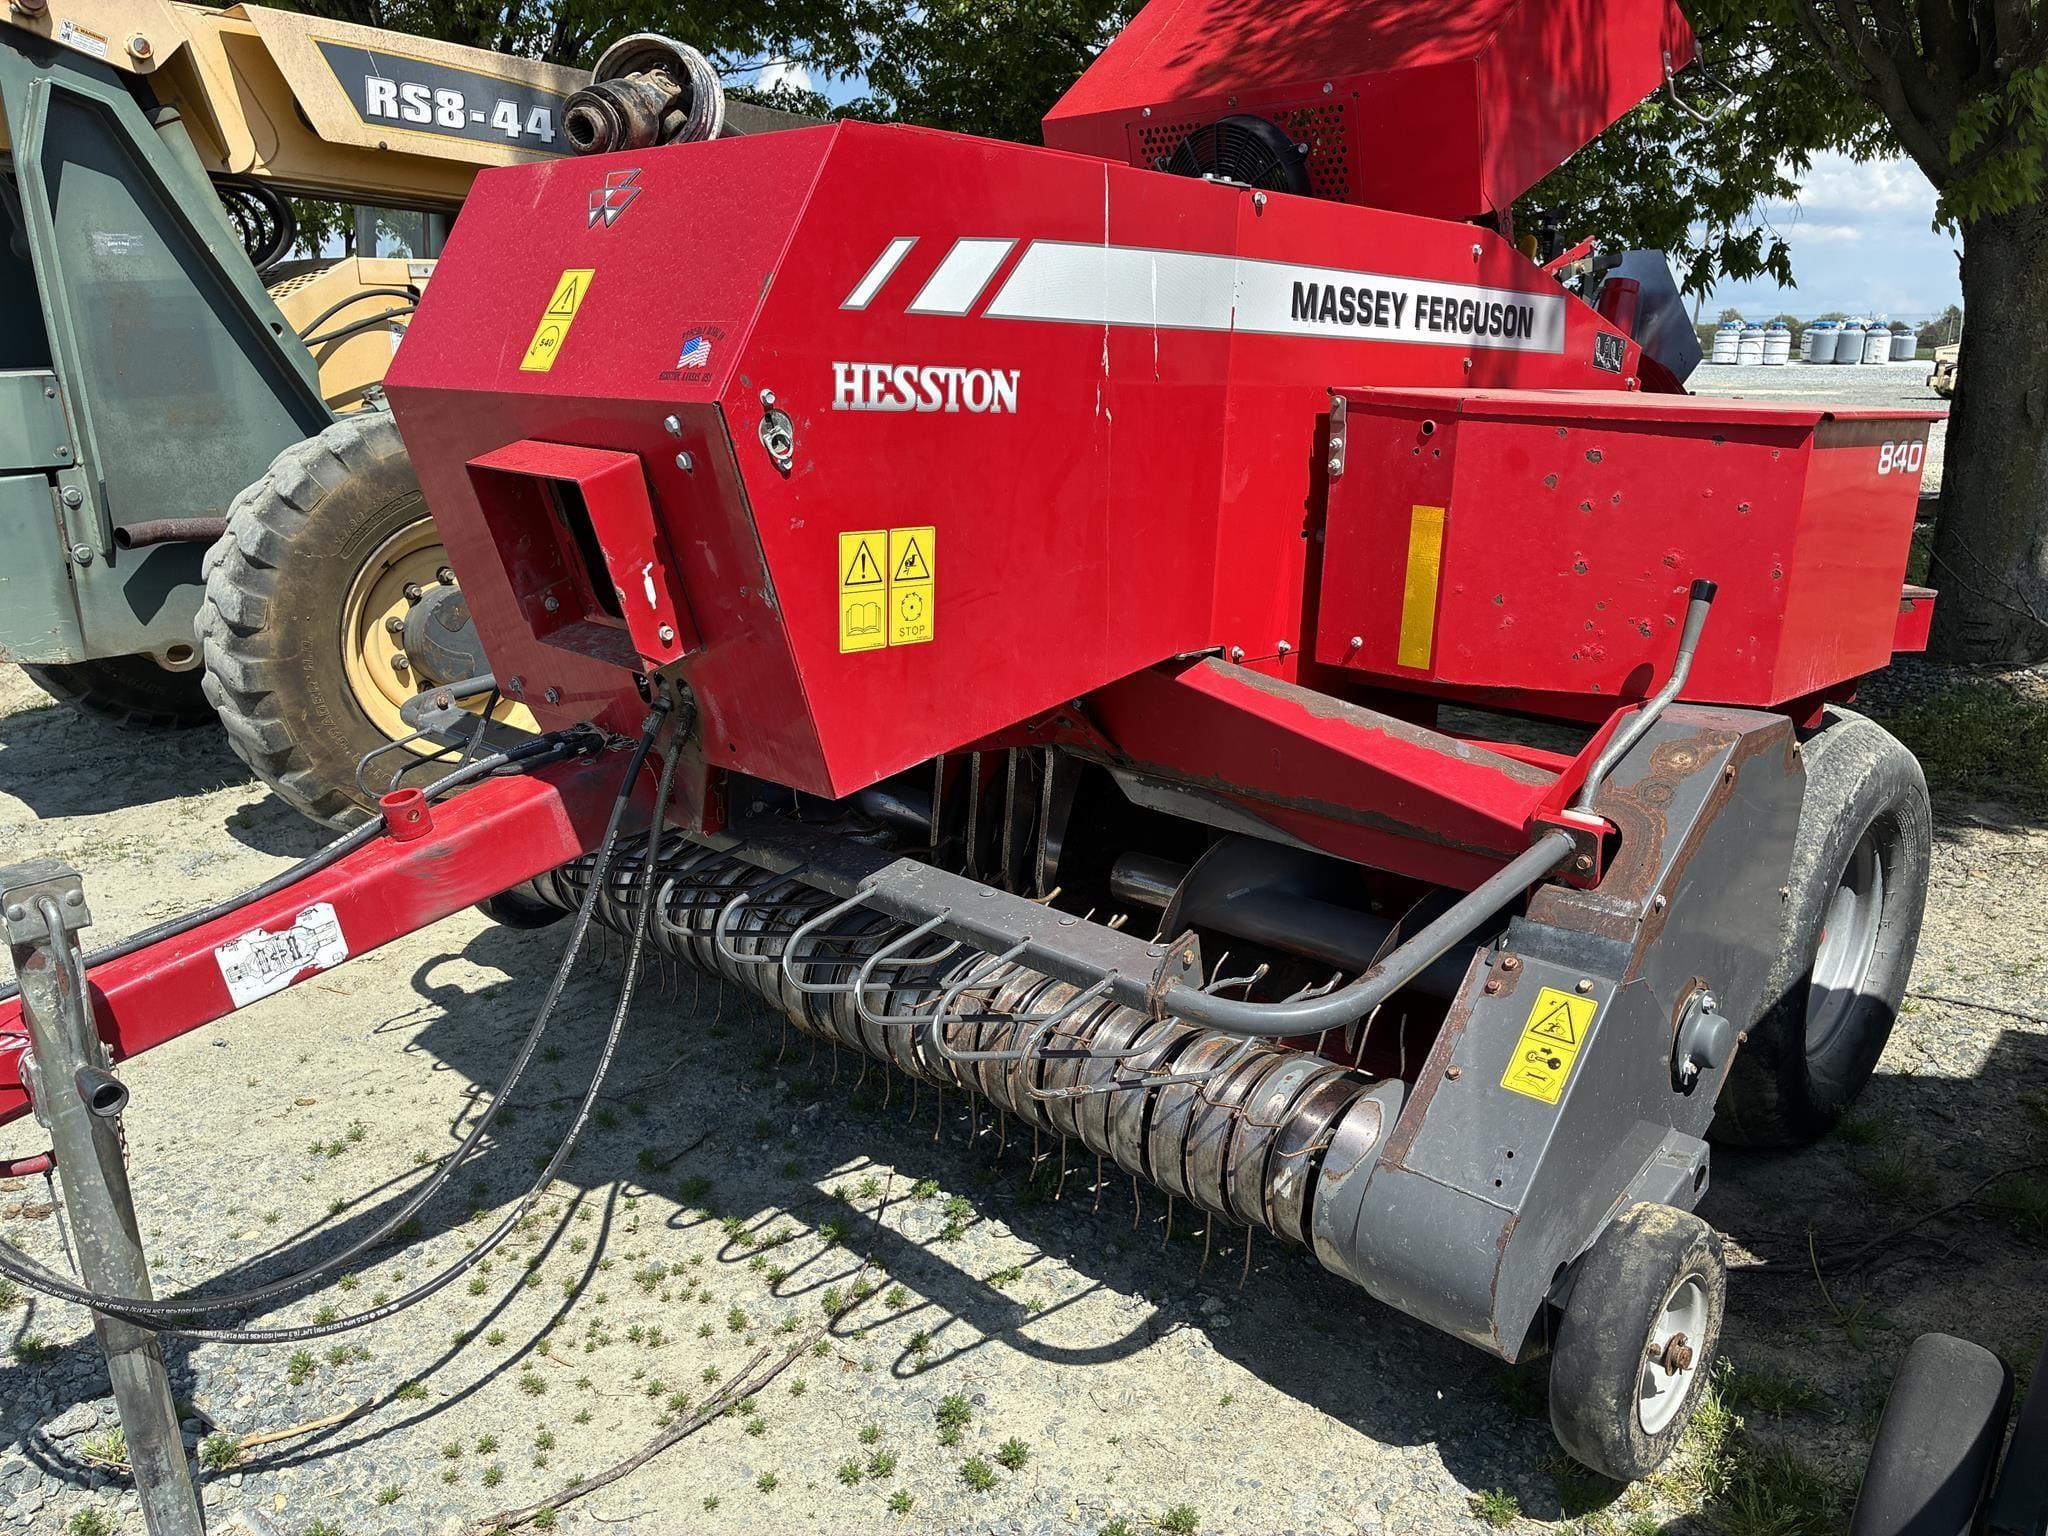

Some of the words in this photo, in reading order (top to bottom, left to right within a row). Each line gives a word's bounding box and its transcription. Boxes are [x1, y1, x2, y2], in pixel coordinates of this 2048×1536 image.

[364, 74, 556, 144] RS8-44
[1290, 281, 1407, 329] MASSEY
[1413, 294, 1535, 339] FERGUSON
[539, 337, 555, 348] 540
[831, 361, 1021, 414] HESSTON
[1877, 439, 1924, 475] 840
[899, 624, 926, 638] STOP
